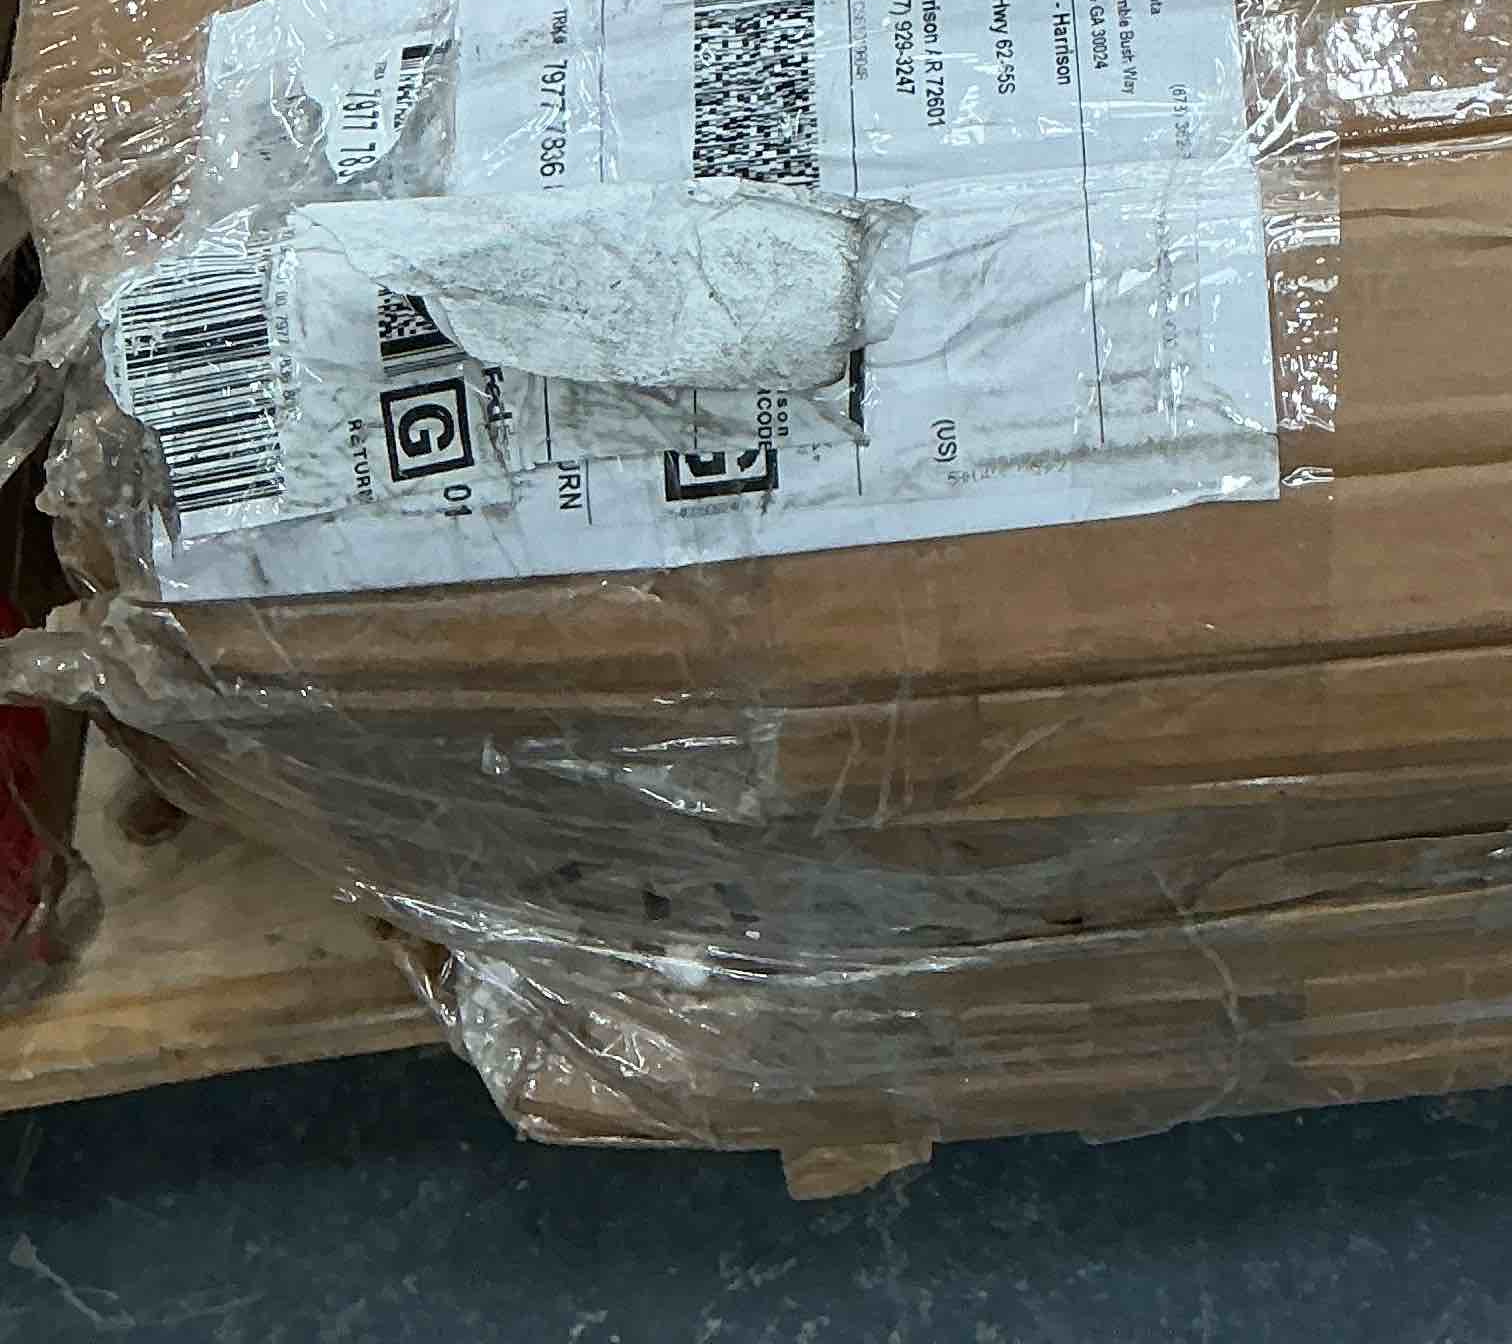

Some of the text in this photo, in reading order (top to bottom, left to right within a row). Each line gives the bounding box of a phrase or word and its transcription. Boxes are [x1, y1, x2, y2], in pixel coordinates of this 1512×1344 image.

[1089, 6, 1105, 26] GA
[894, 20, 916, 96] 929-3247
[1052, 13, 1072, 86] Harrison
[1091, 28, 1109, 70] 30024
[1119, 31, 1135, 64] Bush
[539, 59, 569, 113] 7977
[926, 78, 946, 128] 72601
[1121, 67, 1137, 95] Way
[342, 88, 382, 130] 7977
[539, 122, 570, 178] 7836
[397, 402, 456, 458] G
[929, 418, 958, 464] (US)
[443, 483, 473, 518] 01
